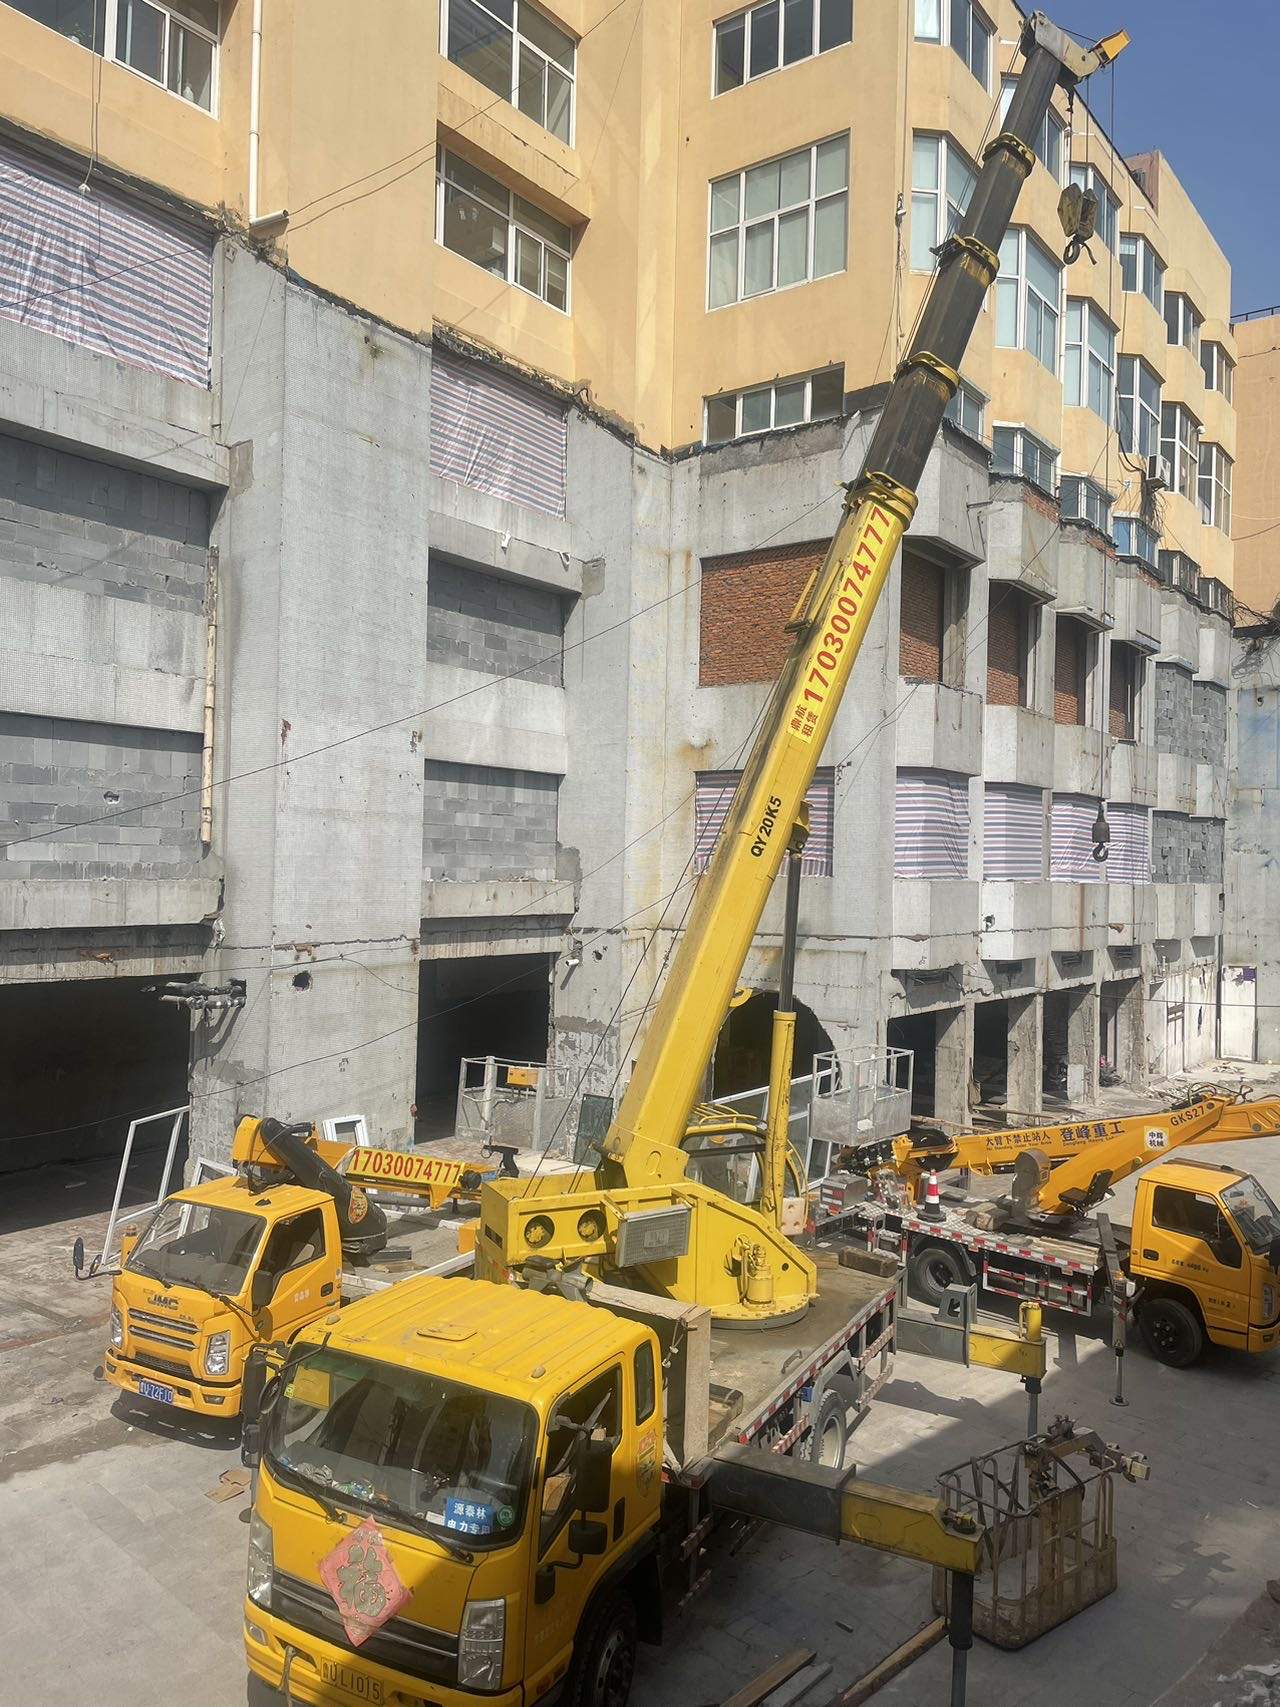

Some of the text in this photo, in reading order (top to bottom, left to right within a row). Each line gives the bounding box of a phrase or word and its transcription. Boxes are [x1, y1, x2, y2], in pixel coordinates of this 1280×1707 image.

[804, 506, 891, 703] 17030074777
[1170, 1105, 1205, 1126] GKS27
[985, 1130, 1051, 1146] 大臂下禁止站人
[1060, 1120, 1125, 1143] 登峰重工
[353, 1149, 461, 1184] 17030074777
[453, 1502, 487, 1520] 源泰林
